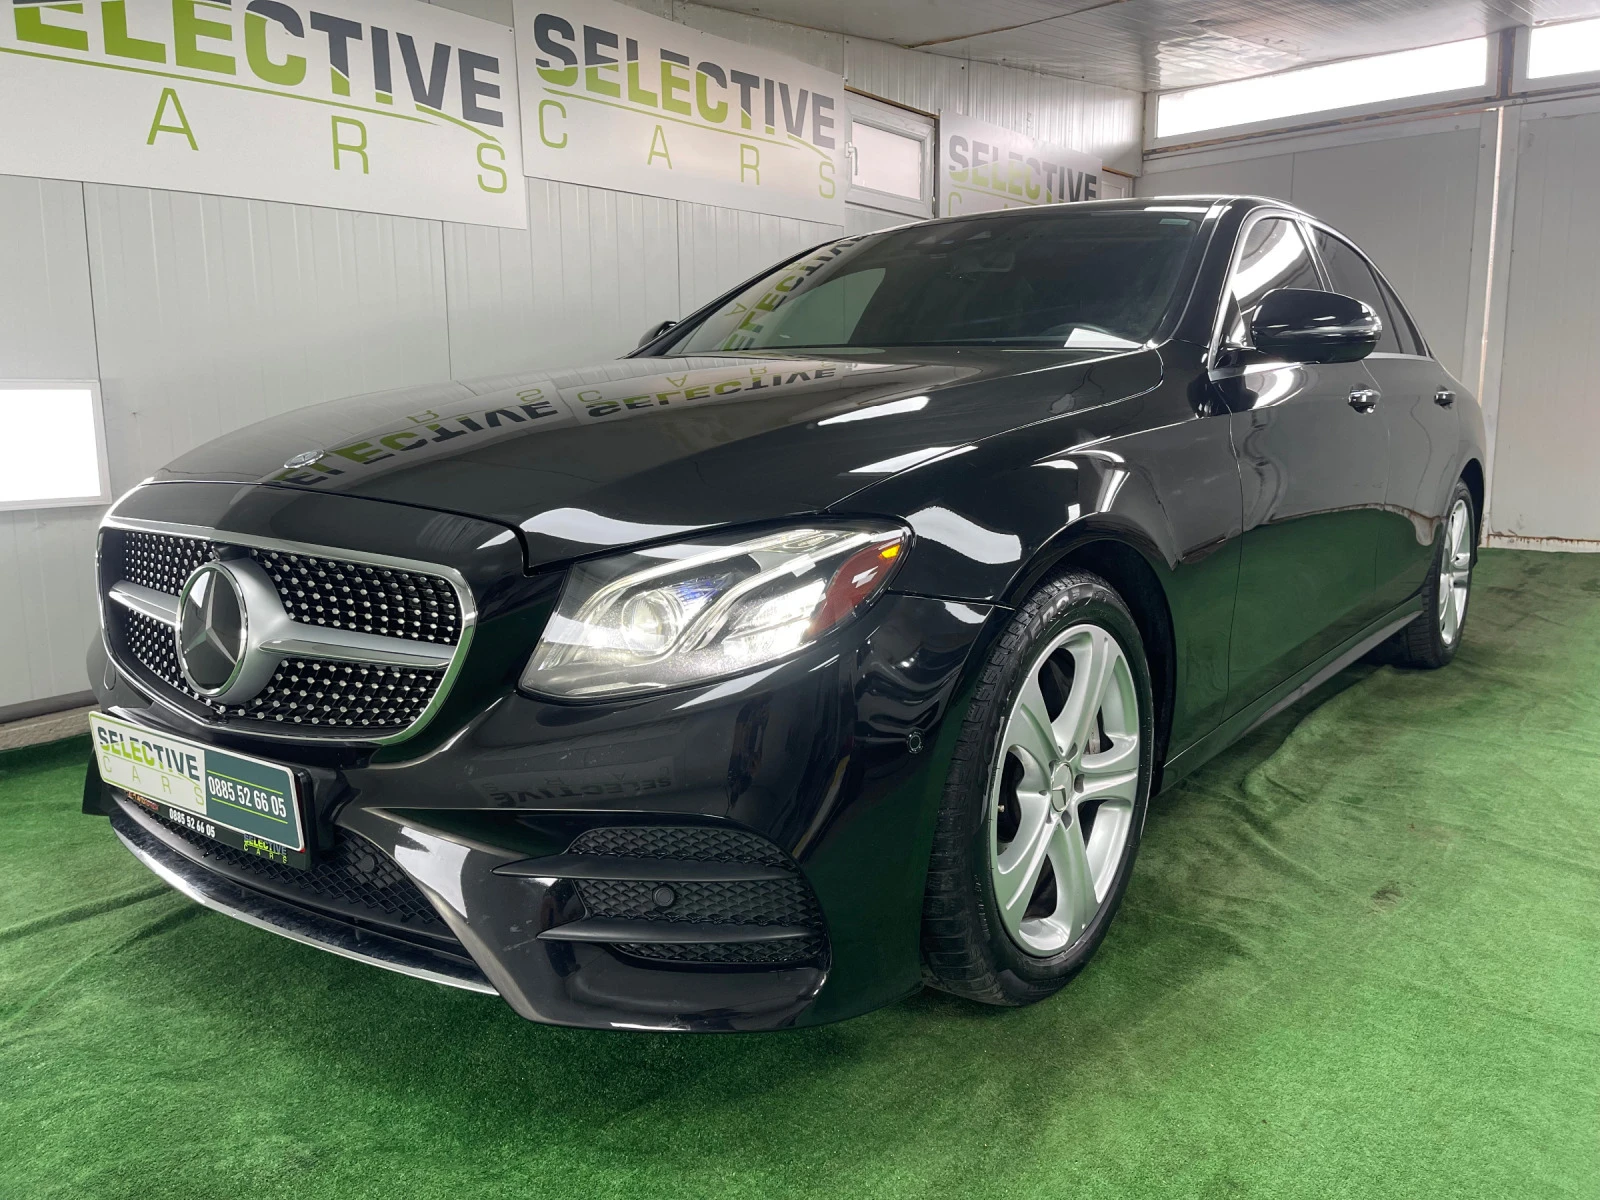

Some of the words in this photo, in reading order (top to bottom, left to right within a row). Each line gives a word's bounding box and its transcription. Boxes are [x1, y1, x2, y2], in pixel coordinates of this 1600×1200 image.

[533, 13, 836, 151] SELECTIVE
[948, 135, 1097, 204] SELECTIVE
[97, 726, 201, 782] SELECTIVE
[169, 808, 185, 825] 0885
[186, 815, 195, 830] 52
[196, 820, 205, 833] 66
[206, 824, 216, 838] 05
[208, 776, 236, 802] 0885
[237, 785, 252, 807] 52
[254, 790, 269, 812] 66
[271, 795, 287, 818] 05
